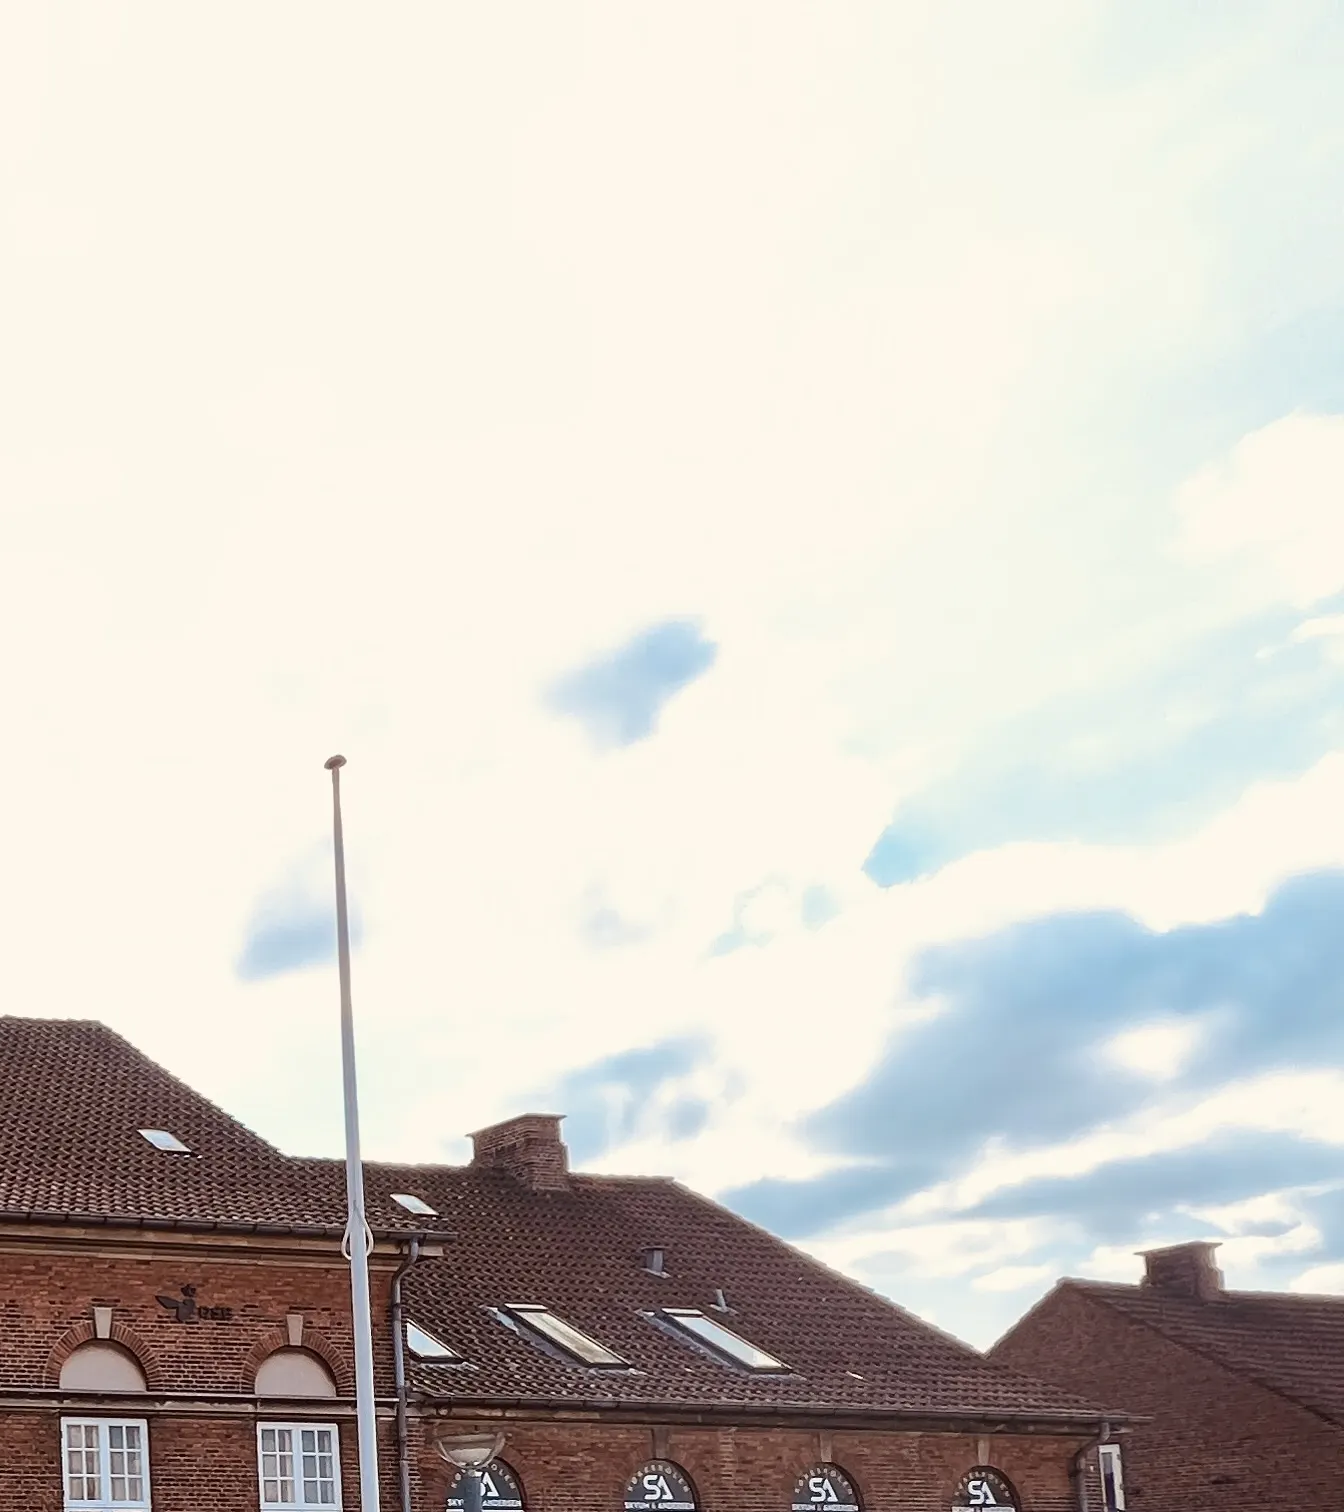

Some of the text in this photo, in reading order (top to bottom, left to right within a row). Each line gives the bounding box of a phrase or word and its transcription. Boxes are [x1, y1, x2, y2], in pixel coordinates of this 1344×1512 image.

[643, 1474, 674, 1500] SA
[809, 1477, 839, 1502] SA
[968, 1480, 997, 1505] SA
